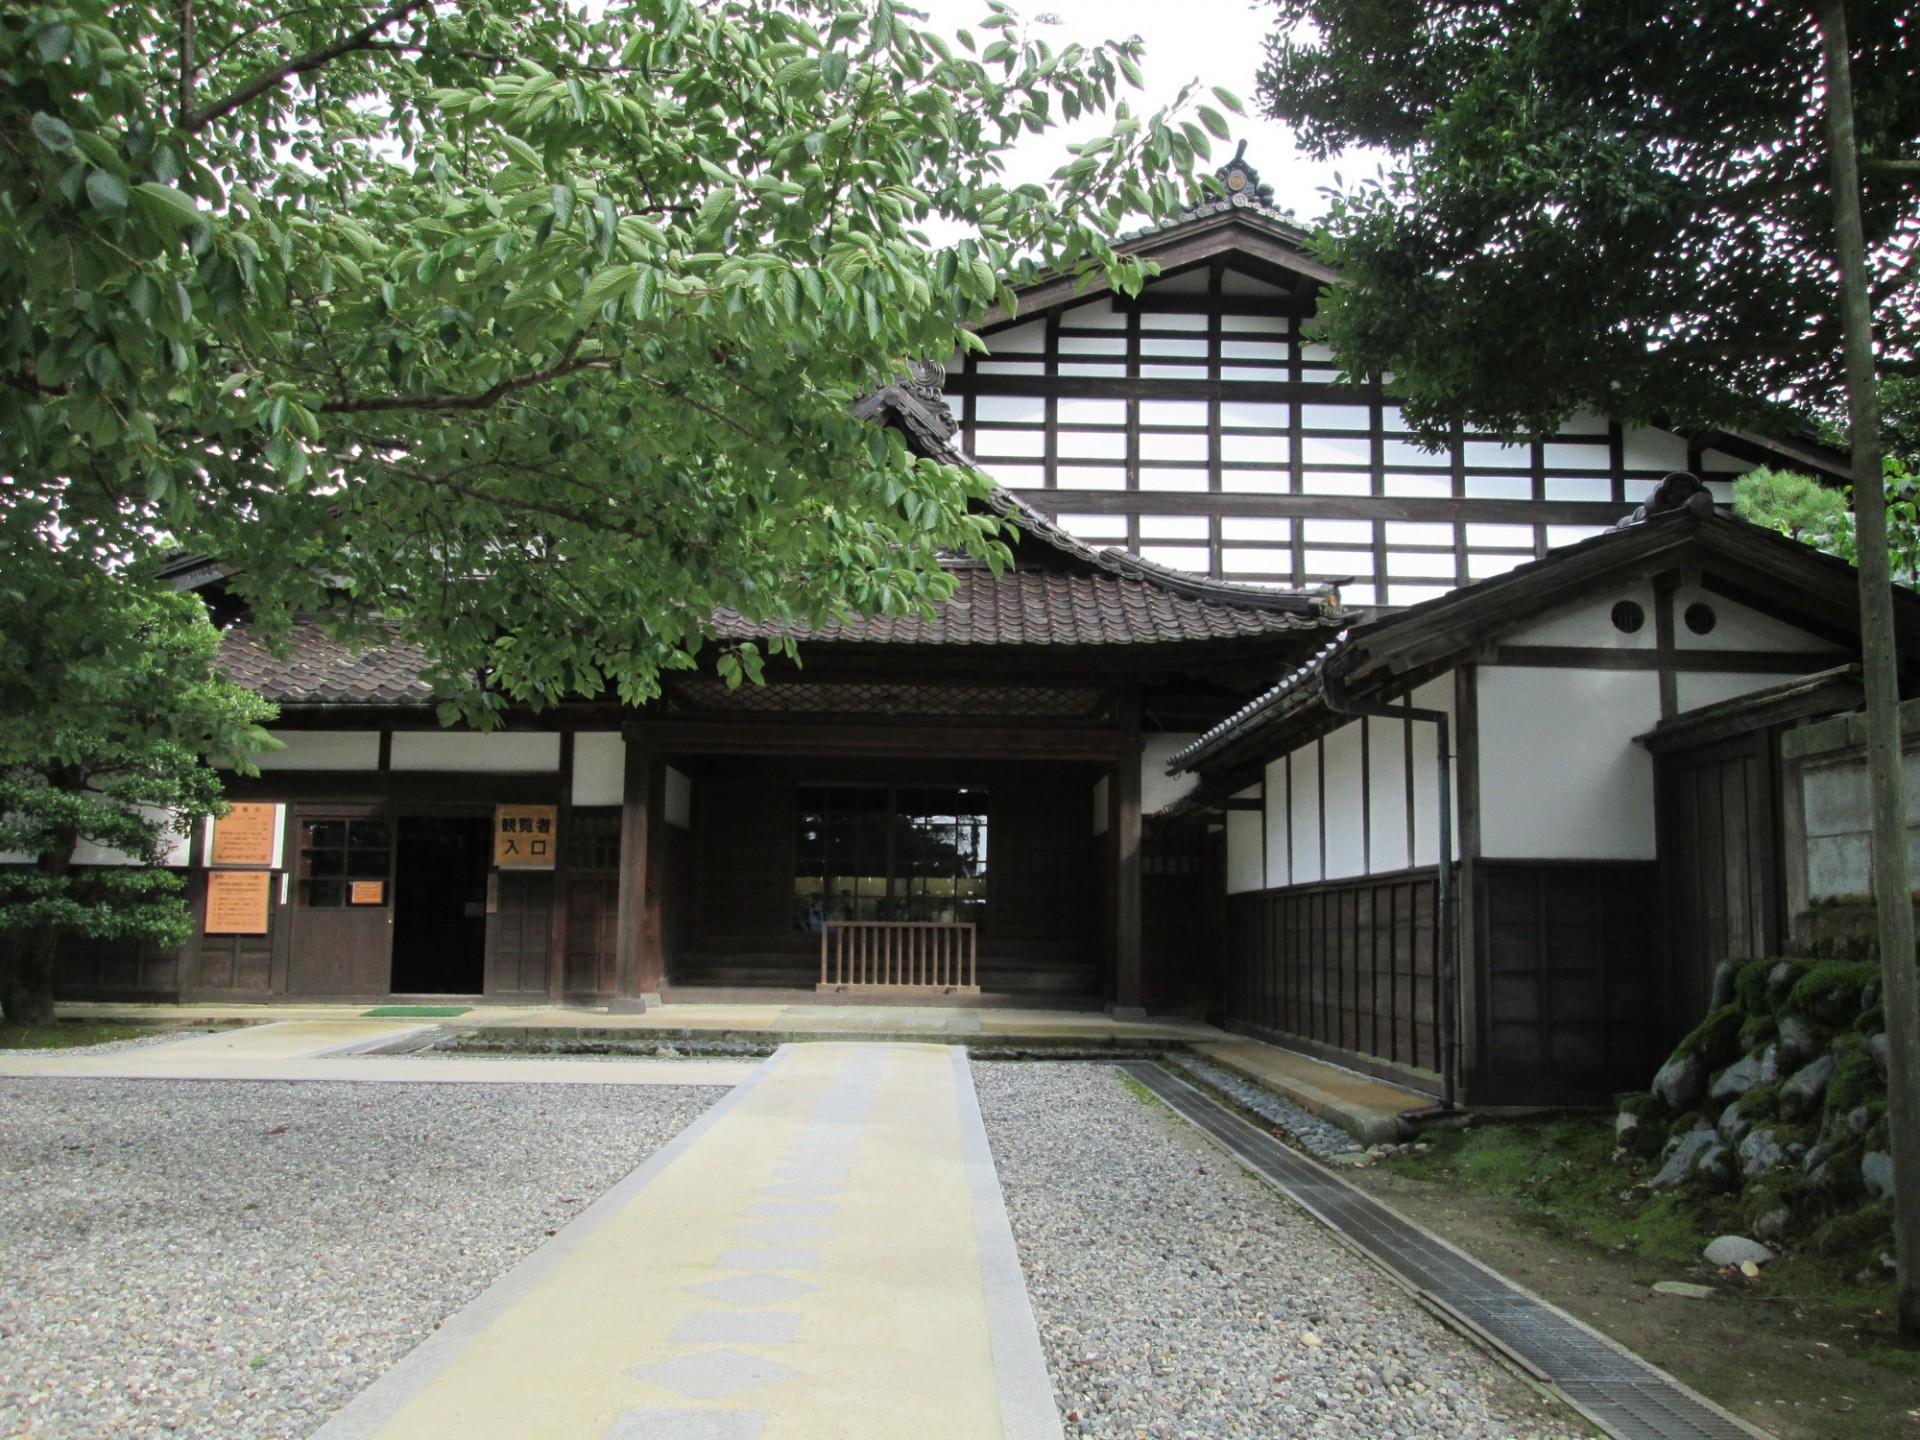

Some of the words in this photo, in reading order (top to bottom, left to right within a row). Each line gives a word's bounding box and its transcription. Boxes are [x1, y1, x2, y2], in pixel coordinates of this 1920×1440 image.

[502, 818, 551, 833] 観覧者
[505, 840, 546, 855] 入口
